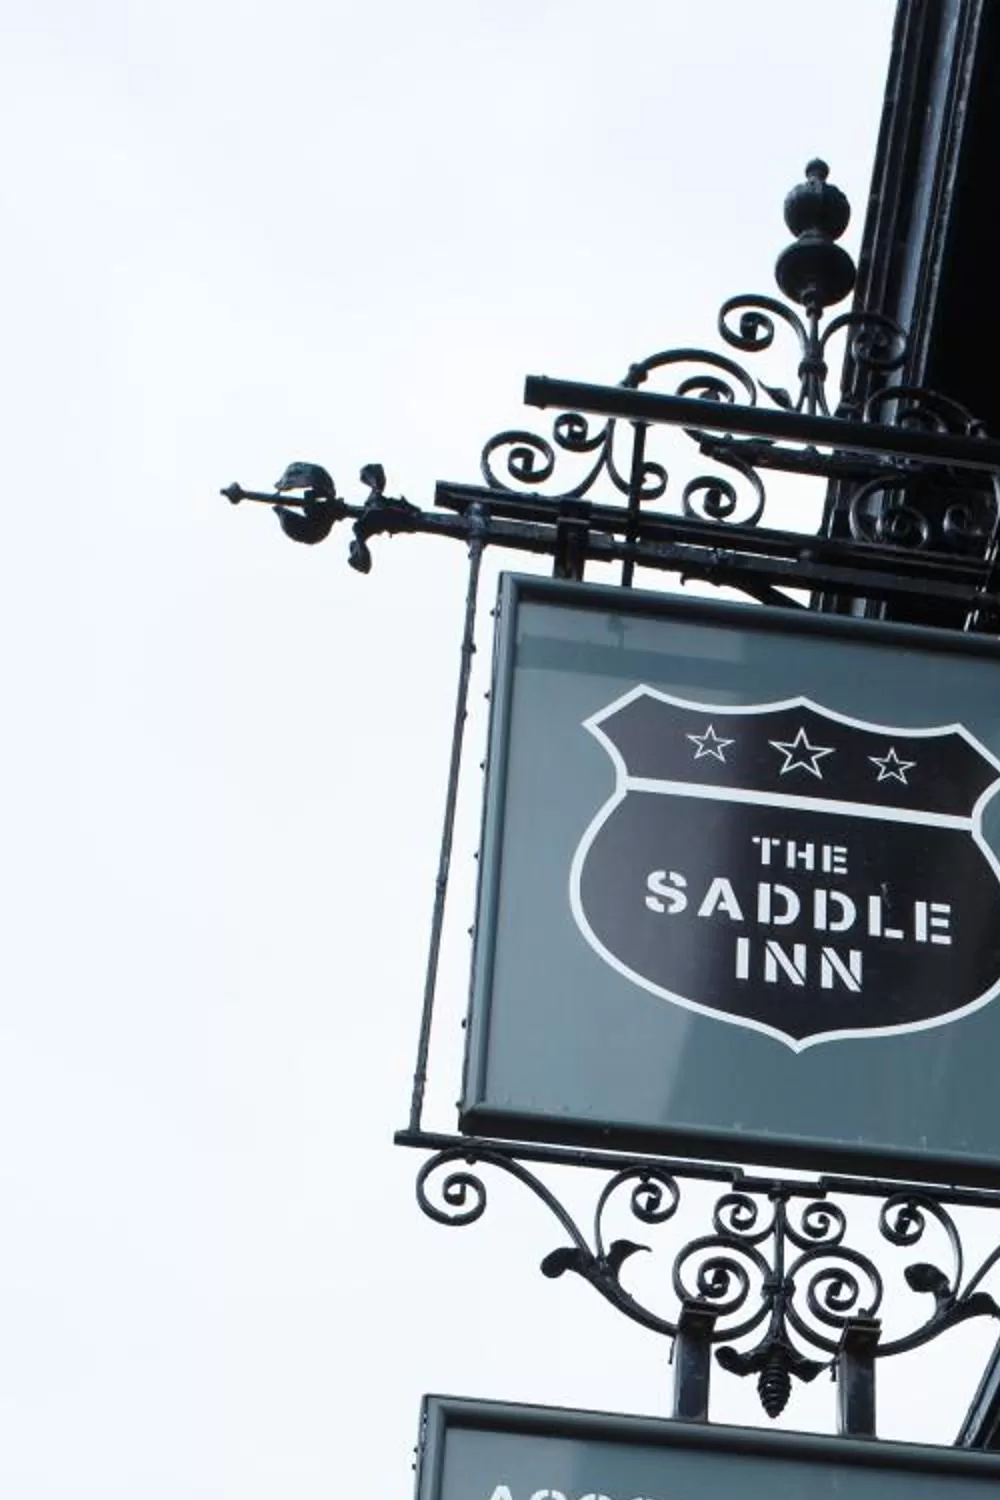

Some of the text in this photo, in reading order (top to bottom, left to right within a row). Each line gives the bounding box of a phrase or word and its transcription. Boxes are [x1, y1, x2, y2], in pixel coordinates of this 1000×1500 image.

[752, 837, 847, 874] THE
[645, 871, 952, 945] SADDLE
[735, 937, 862, 993] INN
